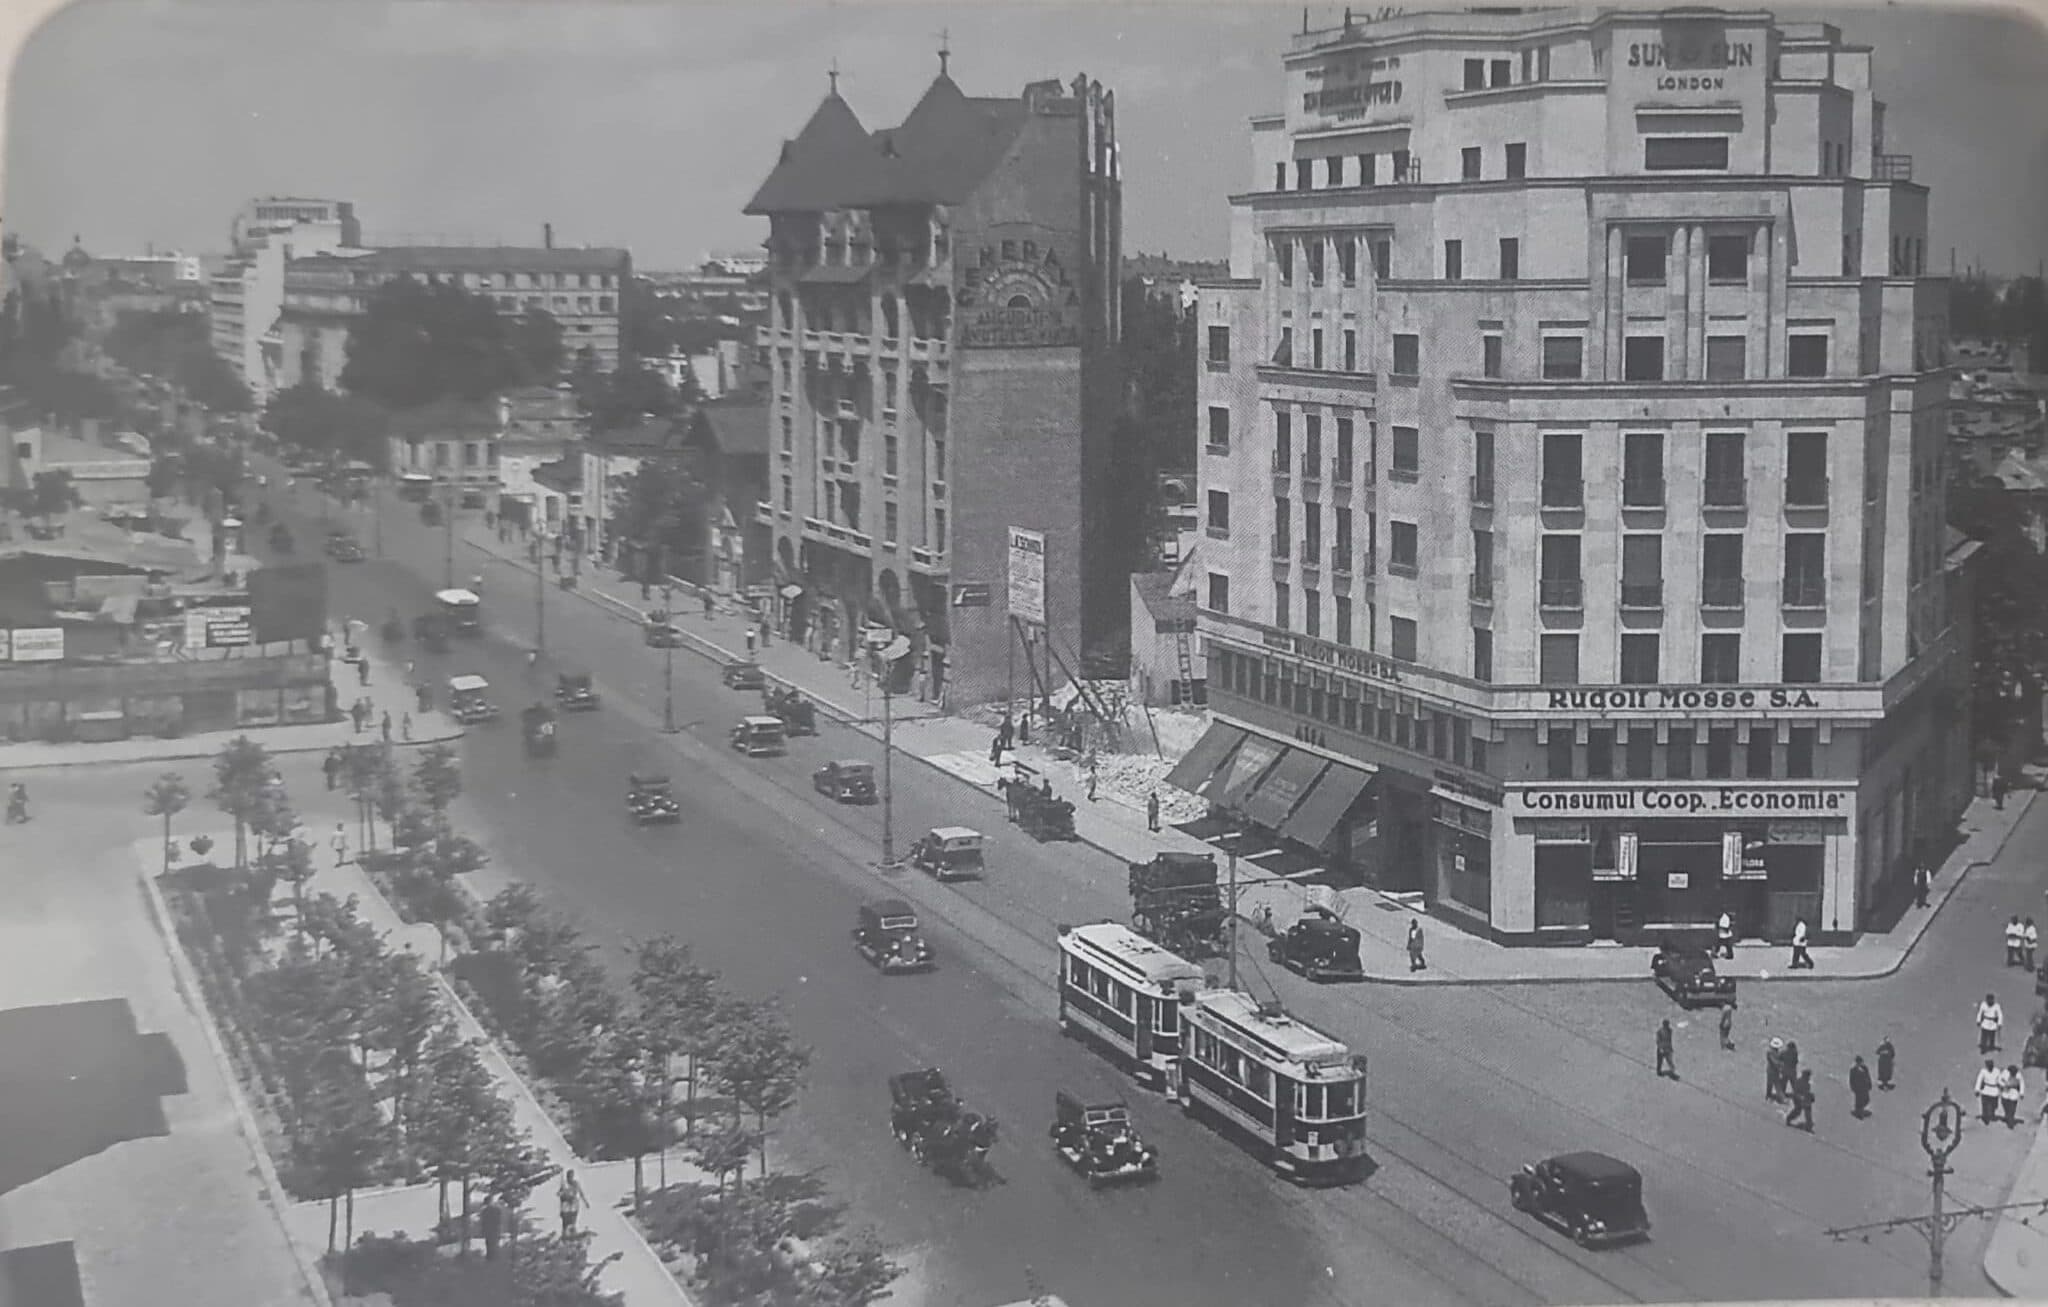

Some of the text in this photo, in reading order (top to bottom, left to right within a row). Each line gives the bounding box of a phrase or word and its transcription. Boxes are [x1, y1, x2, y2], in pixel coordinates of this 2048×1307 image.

[1657, 77, 1724, 90] LONDON
[1658, 687, 1755, 709] Mosse
[1769, 688, 1820, 708] S.A.
[1522, 788, 1635, 809] Consumul
[1642, 787, 1707, 813] Coop.
